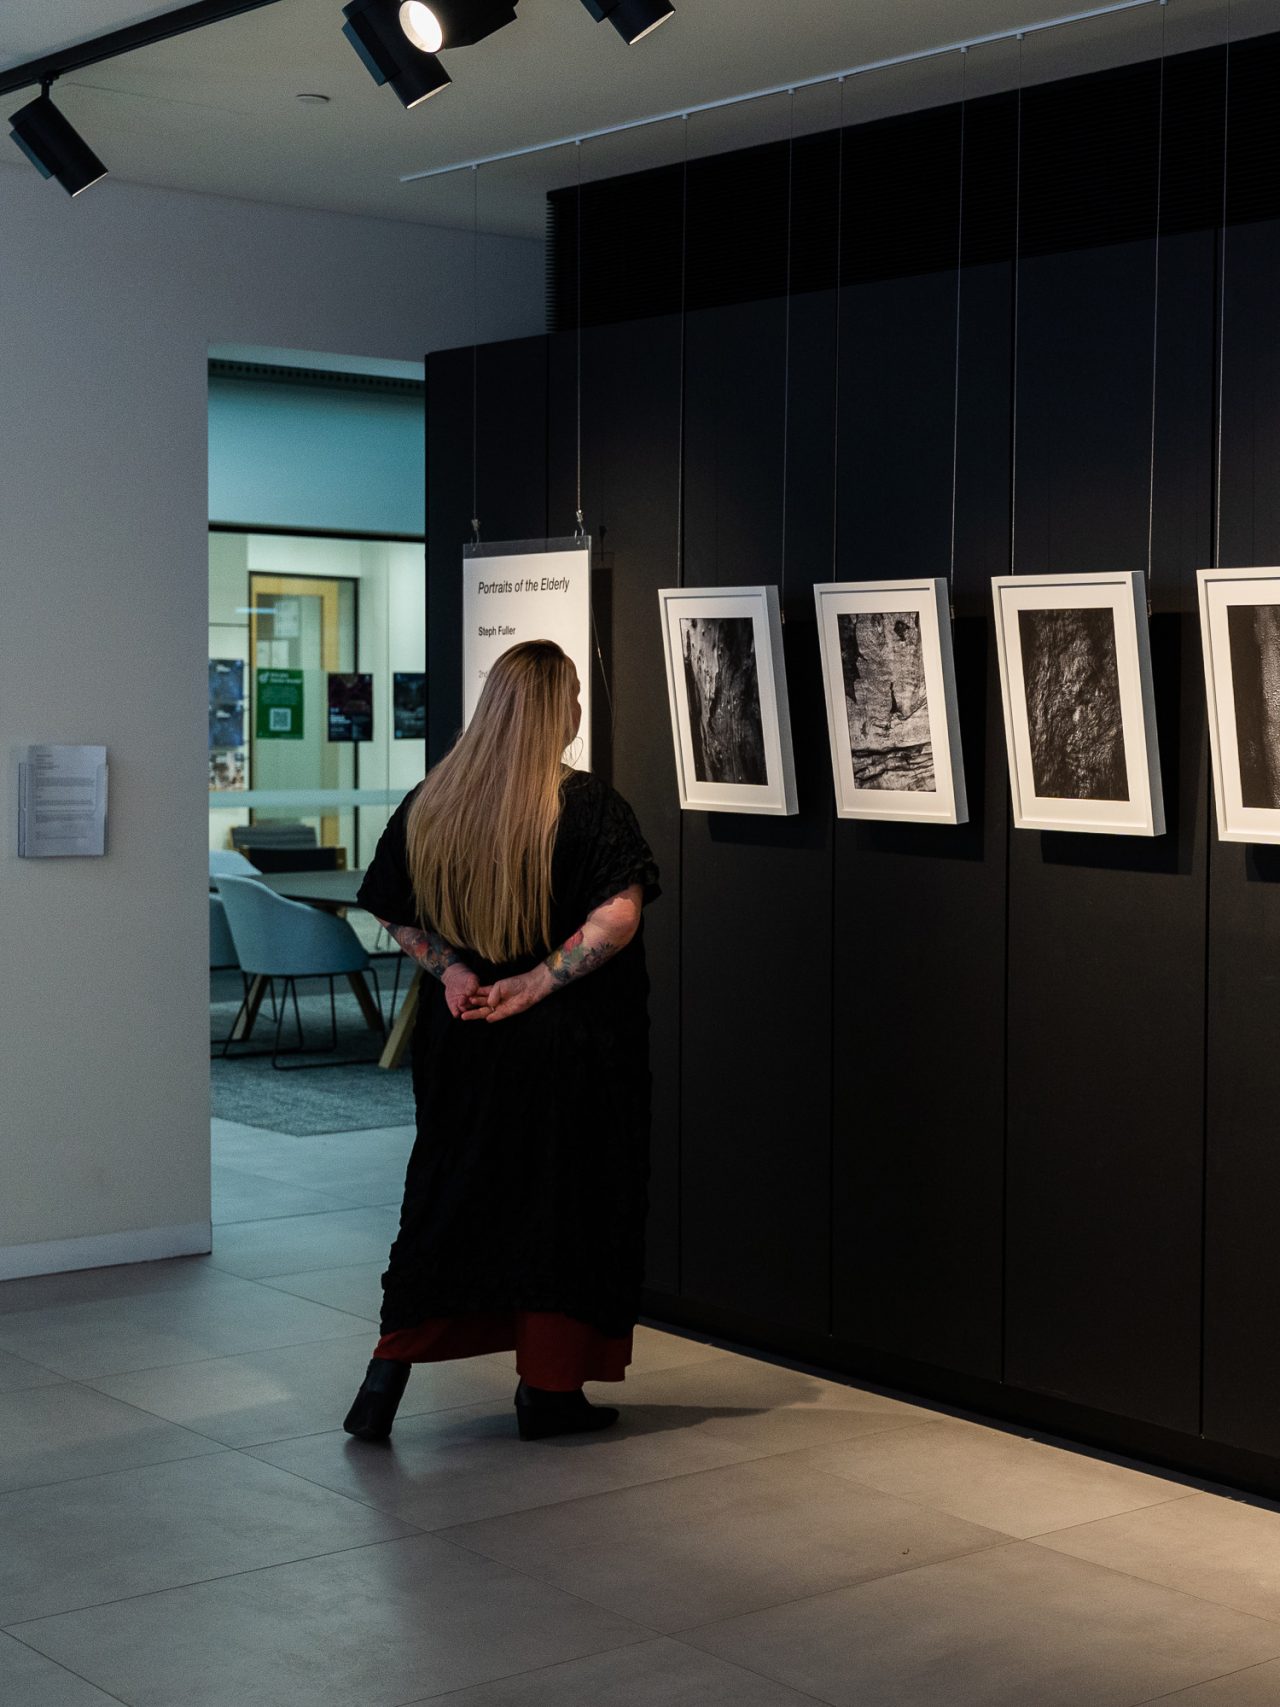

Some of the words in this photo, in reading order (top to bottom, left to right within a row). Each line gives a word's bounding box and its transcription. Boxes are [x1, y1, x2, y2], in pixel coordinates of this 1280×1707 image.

[478, 580, 513, 594] Portraits
[514, 579, 524, 592] of
[525, 578, 539, 592] the
[540, 577, 570, 593] Elderly
[478, 626, 497, 637] Steph
[498, 625, 516, 636] Fuller
